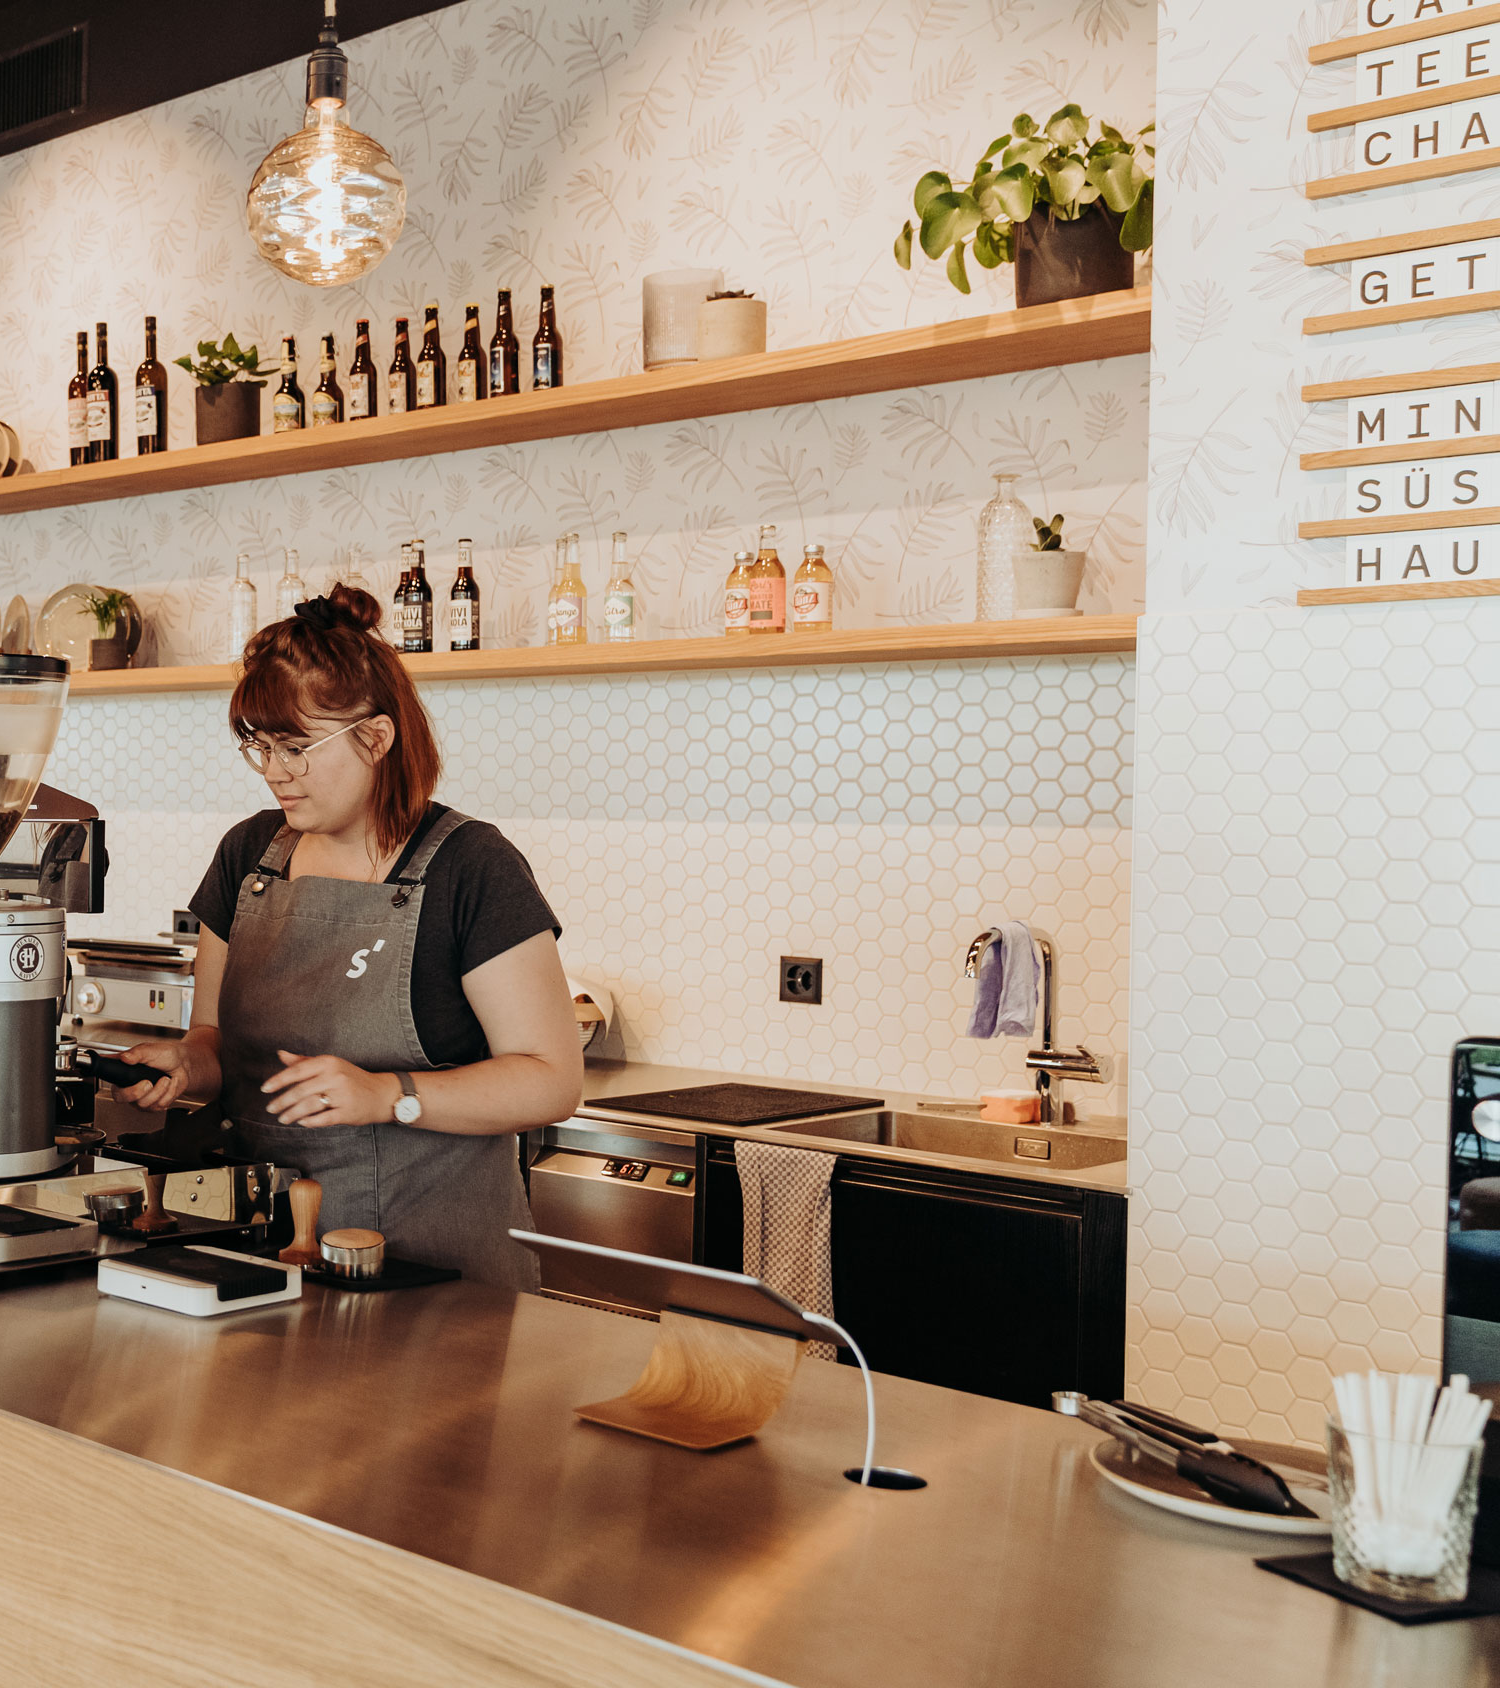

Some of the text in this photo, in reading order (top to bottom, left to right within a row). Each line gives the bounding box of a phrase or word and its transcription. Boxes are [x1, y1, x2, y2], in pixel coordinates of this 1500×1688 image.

[1367, 0, 1474, 28] CA
[1366, 39, 1490, 96] TEE
[1364, 111, 1490, 166] CHA
[1360, 253, 1487, 305] GET
[1357, 397, 1482, 444] MIN
[1356, 467, 1480, 513] SÜS
[1356, 540, 1480, 582] HAU
